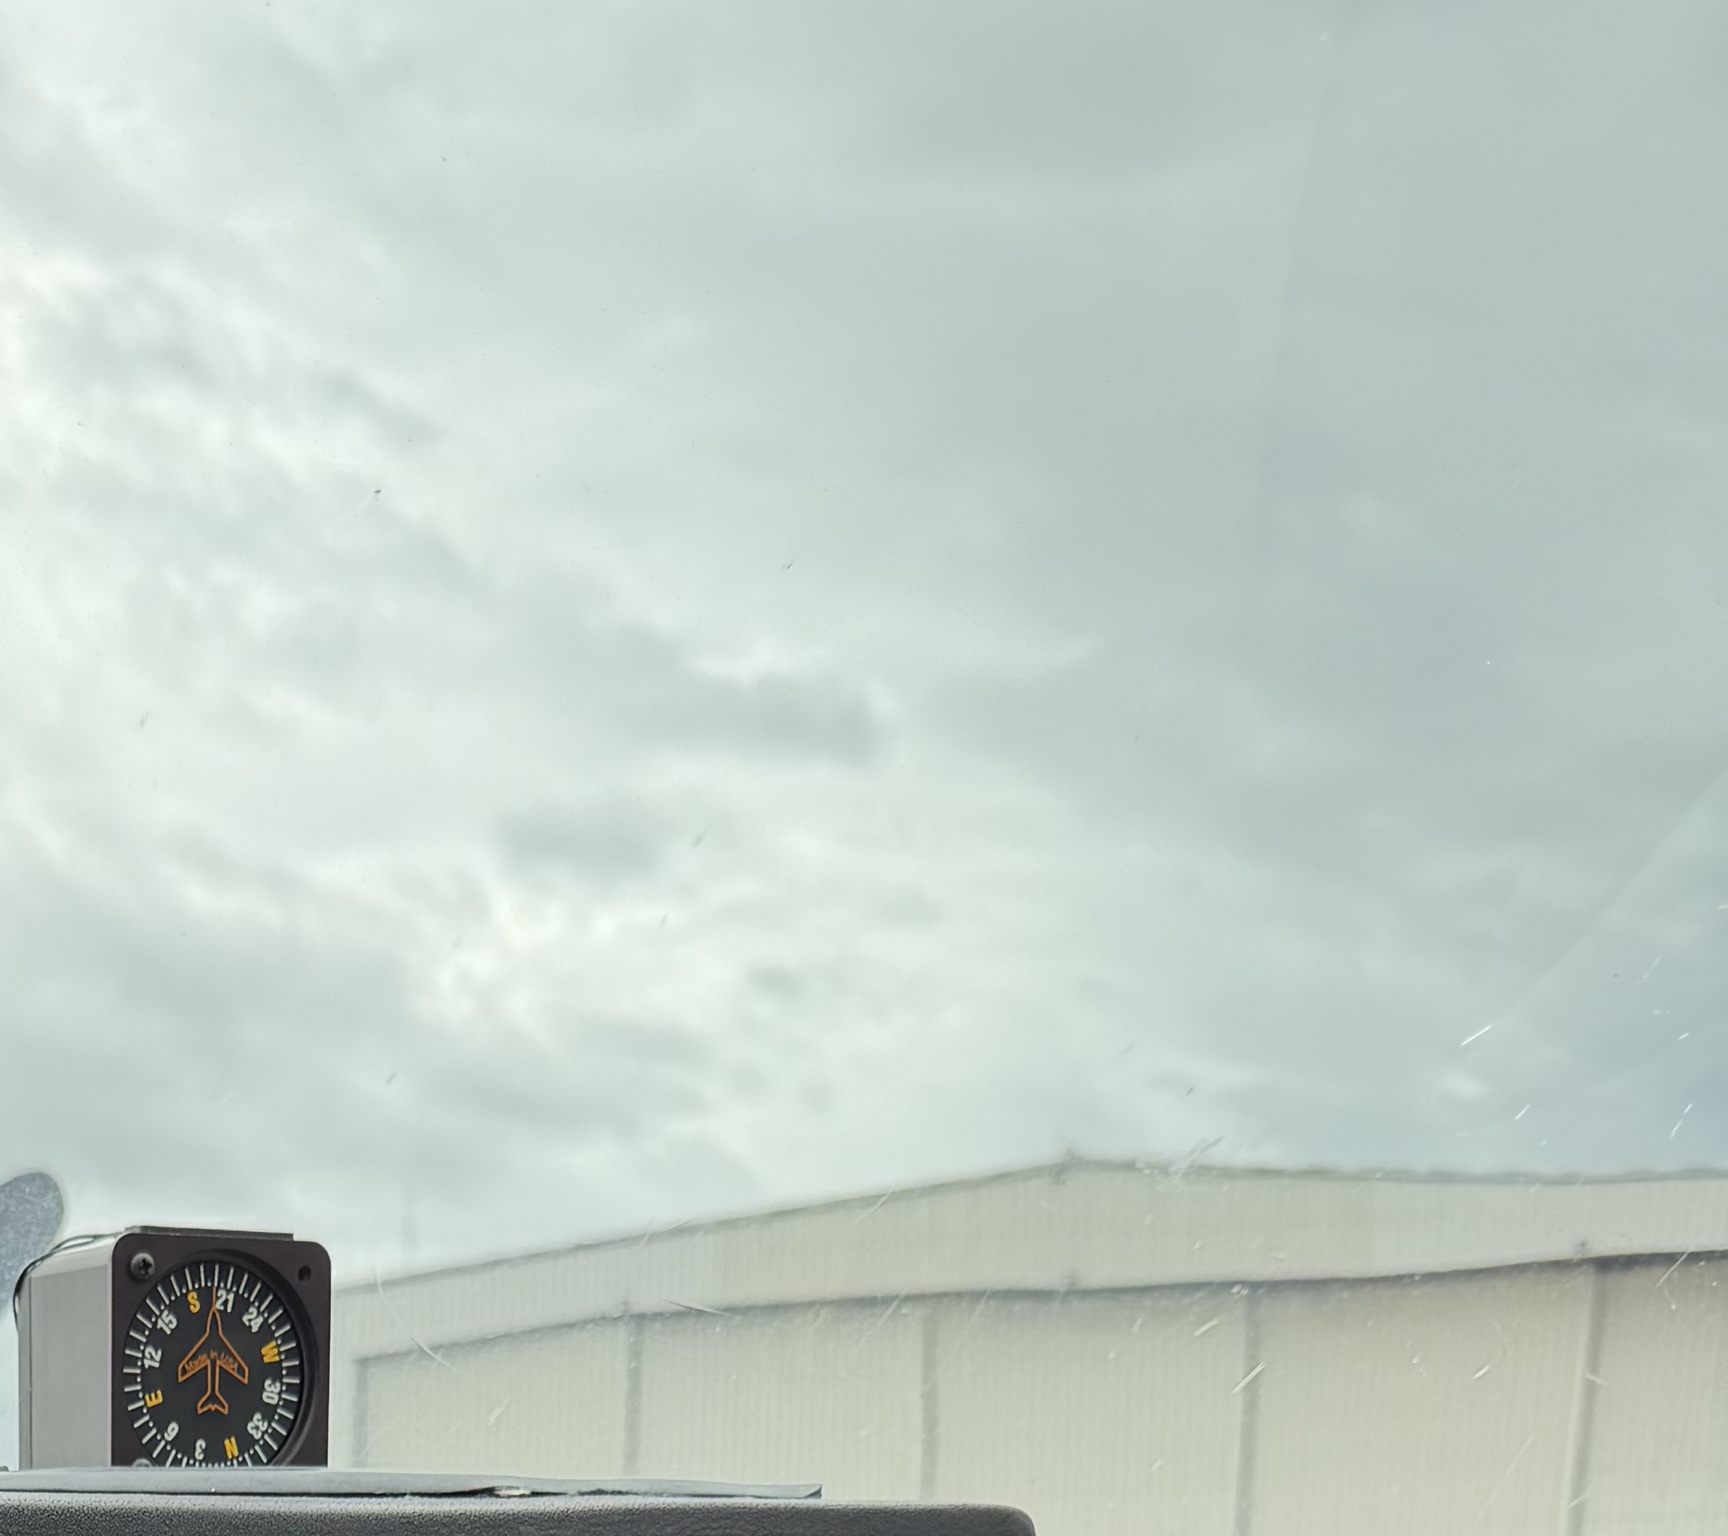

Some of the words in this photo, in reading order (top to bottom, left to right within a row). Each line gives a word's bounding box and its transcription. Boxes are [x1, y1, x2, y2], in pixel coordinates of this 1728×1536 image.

[187, 1292, 200, 1313] S
[216, 1290, 234, 1312] 21
[242, 1308, 264, 1332] 24
[261, 1341, 280, 1363] W
[145, 1390, 162, 1407] E
[224, 1436, 238, 1459] N
